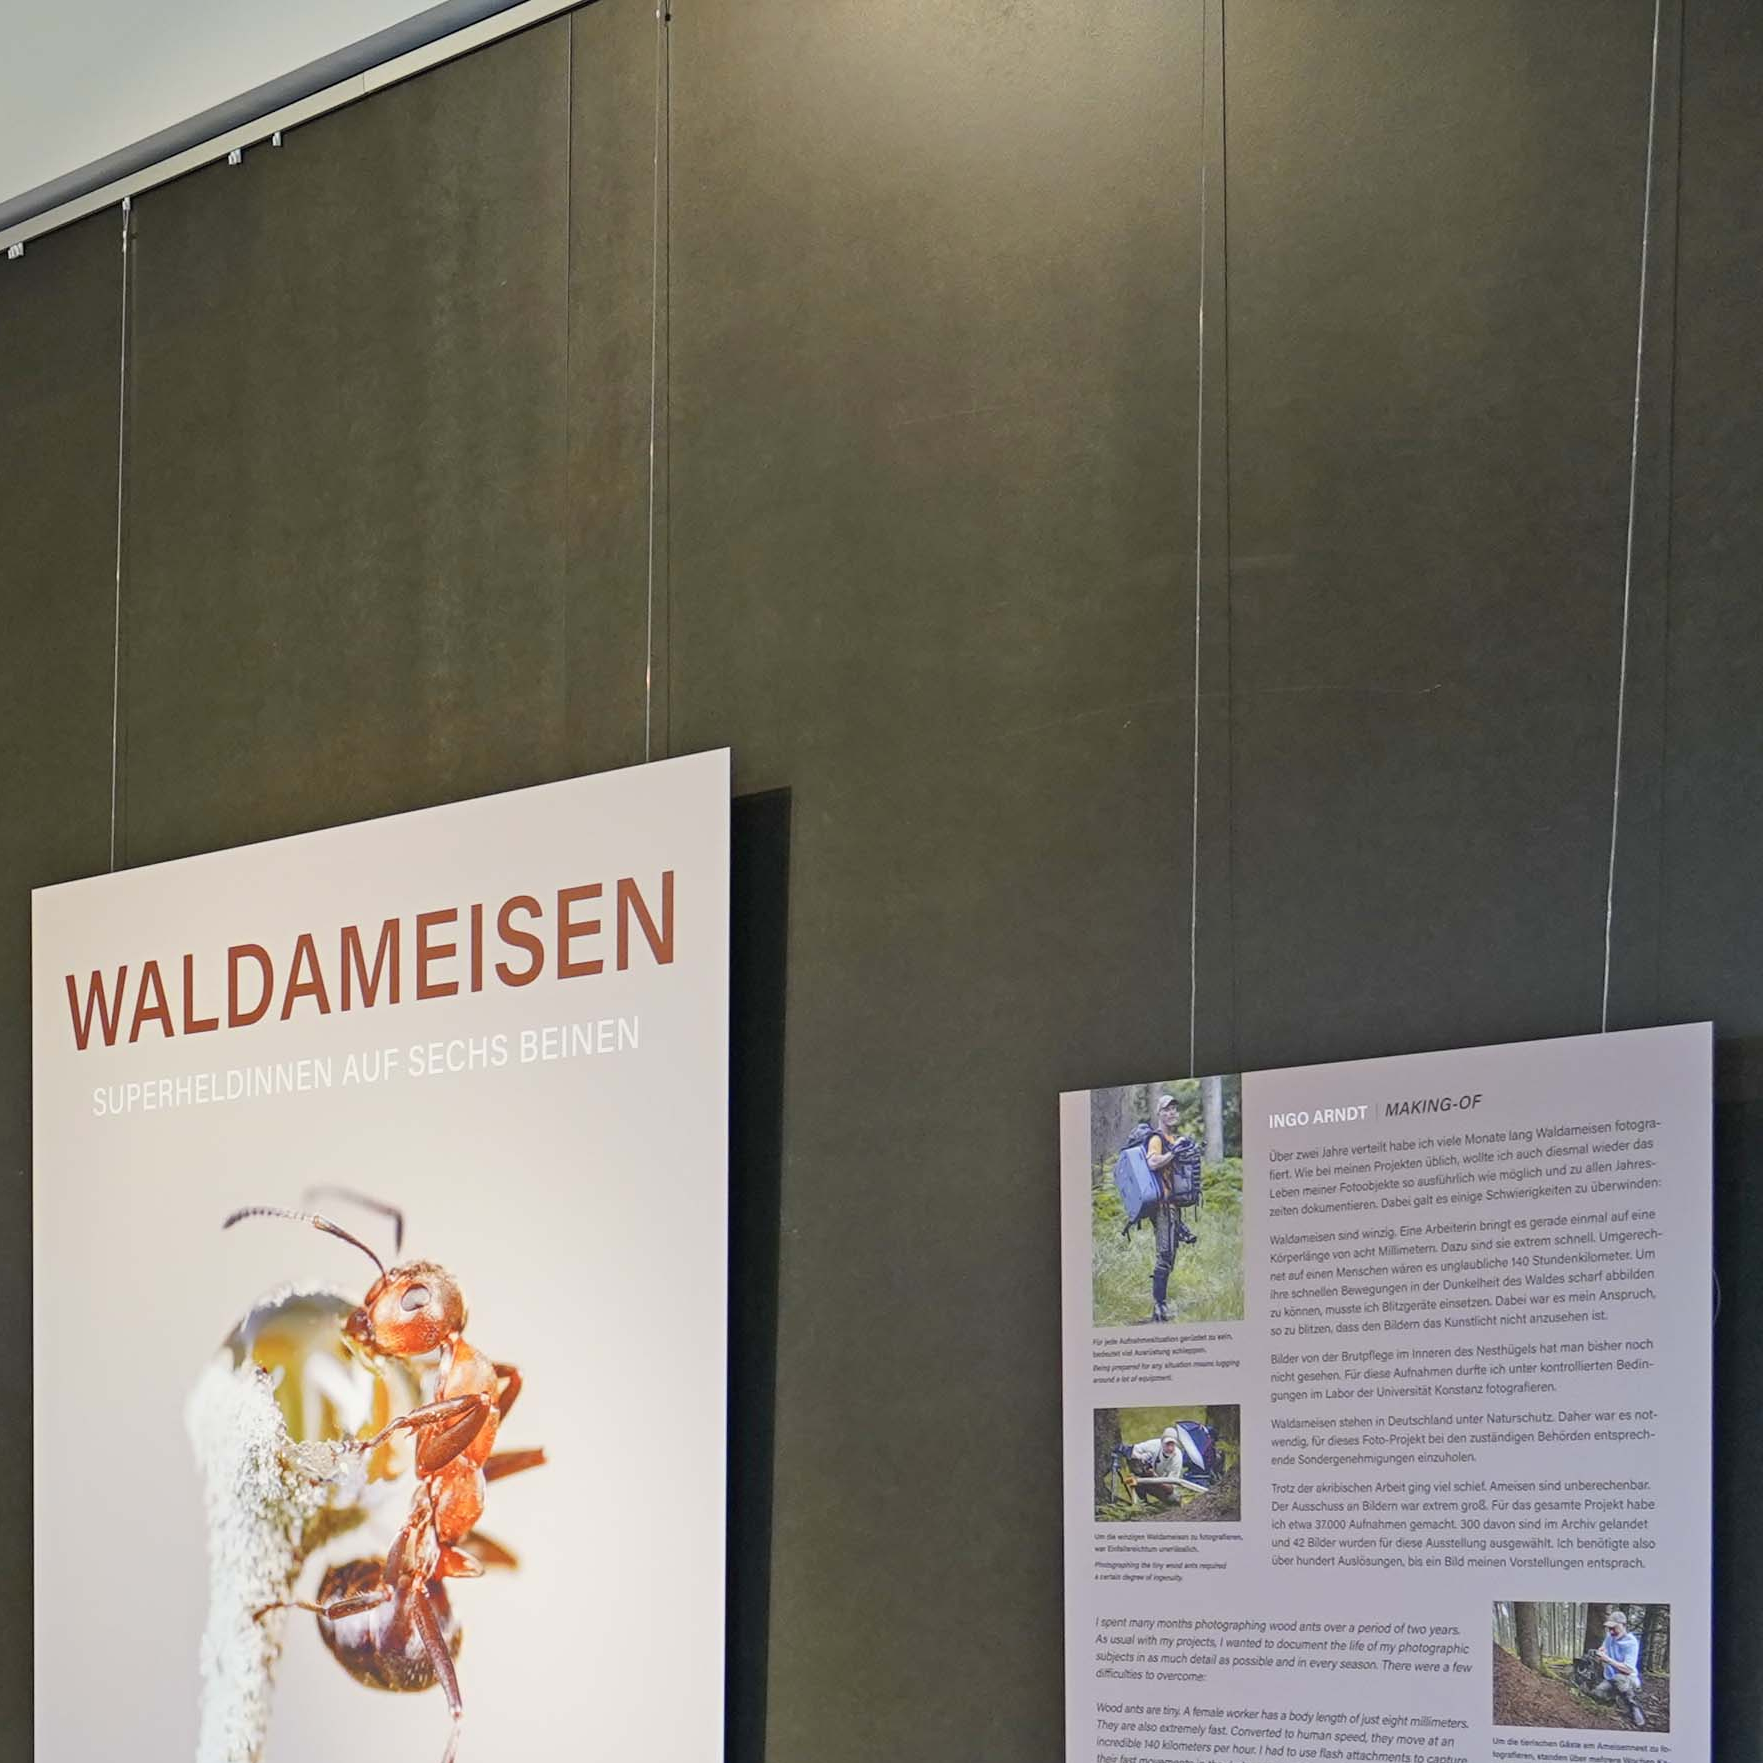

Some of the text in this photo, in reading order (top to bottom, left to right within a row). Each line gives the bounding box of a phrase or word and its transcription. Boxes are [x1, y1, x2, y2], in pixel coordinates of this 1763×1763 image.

[65, 870, 675, 1051] WALDAMEISEN
[92, 1015, 640, 1116] SUPERHELDINNEN AUF SECHS BEINEN
[1268, 1094, 1483, 1129] INGO ARNDT MAKING-OF
[1269, 1119, 1659, 1162] Über zwei Jahre verteilt habe ich viele Monate lang Waldameisen fotogra-
[1294, 1166, 1313, 1178] Wie
[1315, 1164, 1331, 1176] bei
[1333, 1162, 1371, 1175] meinen
[1373, 1157, 1422, 1172] Projekten
[1462, 1151, 1494, 1164] wollte
[1496, 1148, 1513, 1162] ich
[1515, 1146, 1543, 1160] auch
[1545, 1142, 1589, 1158] diesmal
[1591, 1140, 1630, 1154] wieder
[1632, 1138, 1653, 1150] das
[1269, 1158, 1654, 1198] Leben meiner Fotoobjekte so ausführlich wie möglich und zu allen Jahres-
[1269, 1204, 1298, 1217] zeiten
[1380, 1195, 1411, 1209] Dabei
[1413, 1193, 1433, 1209] galt
[1435, 1194, 1448, 1205] es
[1450, 1190, 1483, 1204] einige
[1485, 1184, 1572, 1201] Schwierigkeiten
[1574, 1184, 1589, 1194] zu
[1271, 1537, 1290, 1548] und
[1292, 1537, 1305, 1548] 42
[1307, 1537, 1336, 1548] Bilder
[1338, 1537, 1377, 1548] wurden
[1377, 1537, 1393, 1548] für
[1394, 1537, 1423, 1548] diese
[1424, 1537, 1486, 1551] Ausstellung
[1556, 1538, 1575, 1549] Ich
[1576, 1538, 1629, 1552] benötigte
[1630, 1538, 1655, 1550] also
[1271, 1554, 1294, 1565] über
[1295, 1554, 1335, 1566] hundert
[1407, 1555, 1423, 1566] bis
[1425, 1555, 1441, 1567] ein
[1443, 1555, 1464, 1567] Bild
[1466, 1556, 1506, 1567] meinen
[1508, 1556, 1584, 1570] Vorstellungen
[1095, 1616, 1099, 1626] I
[1100, 1616, 1127, 1629] spent
[1128, 1619, 1155, 1630] many
[1156, 1617, 1193, 1629] months
[1194, 1618, 1266, 1633] photographing
[1268, 1620, 1297, 1631] wood
[1298, 1621, 1321, 1632] ants
[1323, 1623, 1347, 1633] over
[1348, 1624, 1355, 1633] a
[1357, 1622, 1392, 1635] period
[1392, 1623, 1405, 1634] of
[1406, 1623, 1427, 1635] two
